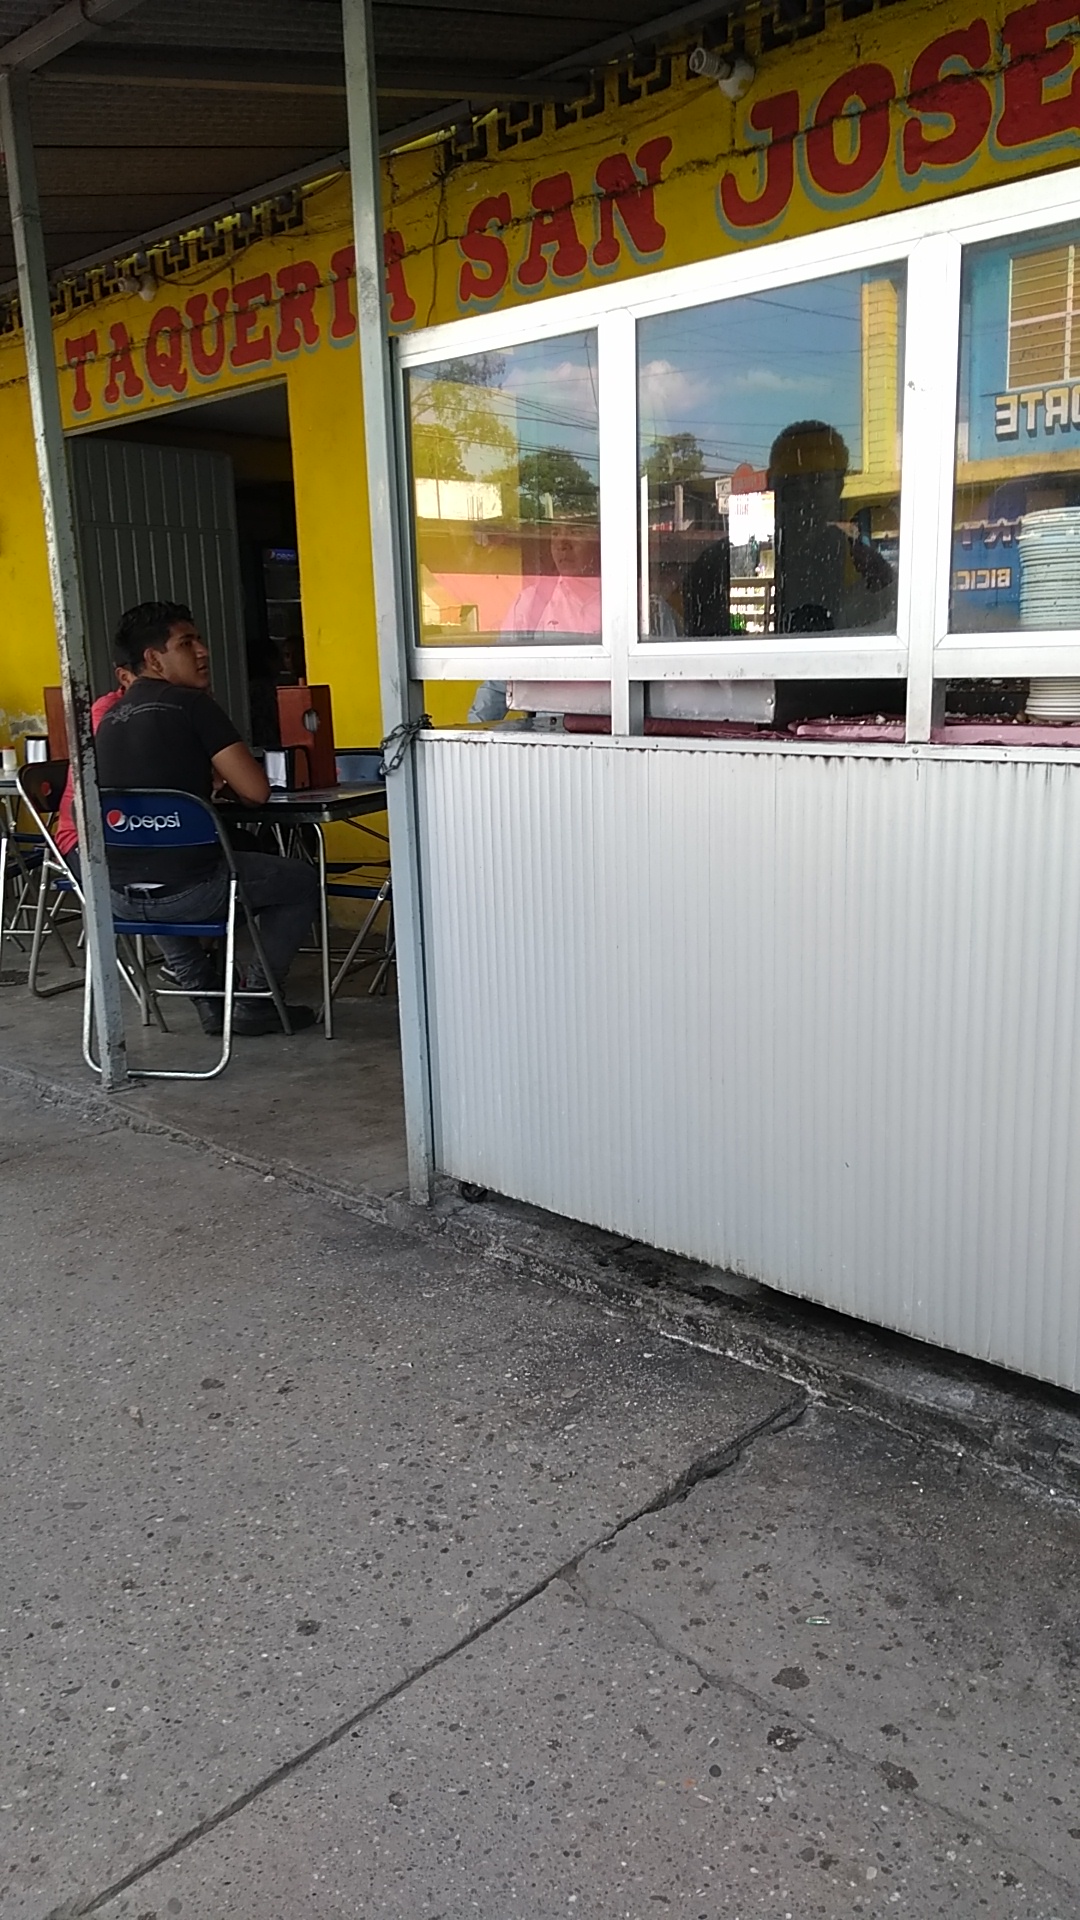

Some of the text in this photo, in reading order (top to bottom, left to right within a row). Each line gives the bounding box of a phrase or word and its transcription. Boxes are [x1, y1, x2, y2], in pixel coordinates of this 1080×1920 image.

[457, 136, 672, 310] SAN
[717, 0, 1080, 238] JOSE
[129, 811, 181, 831] pepsi
